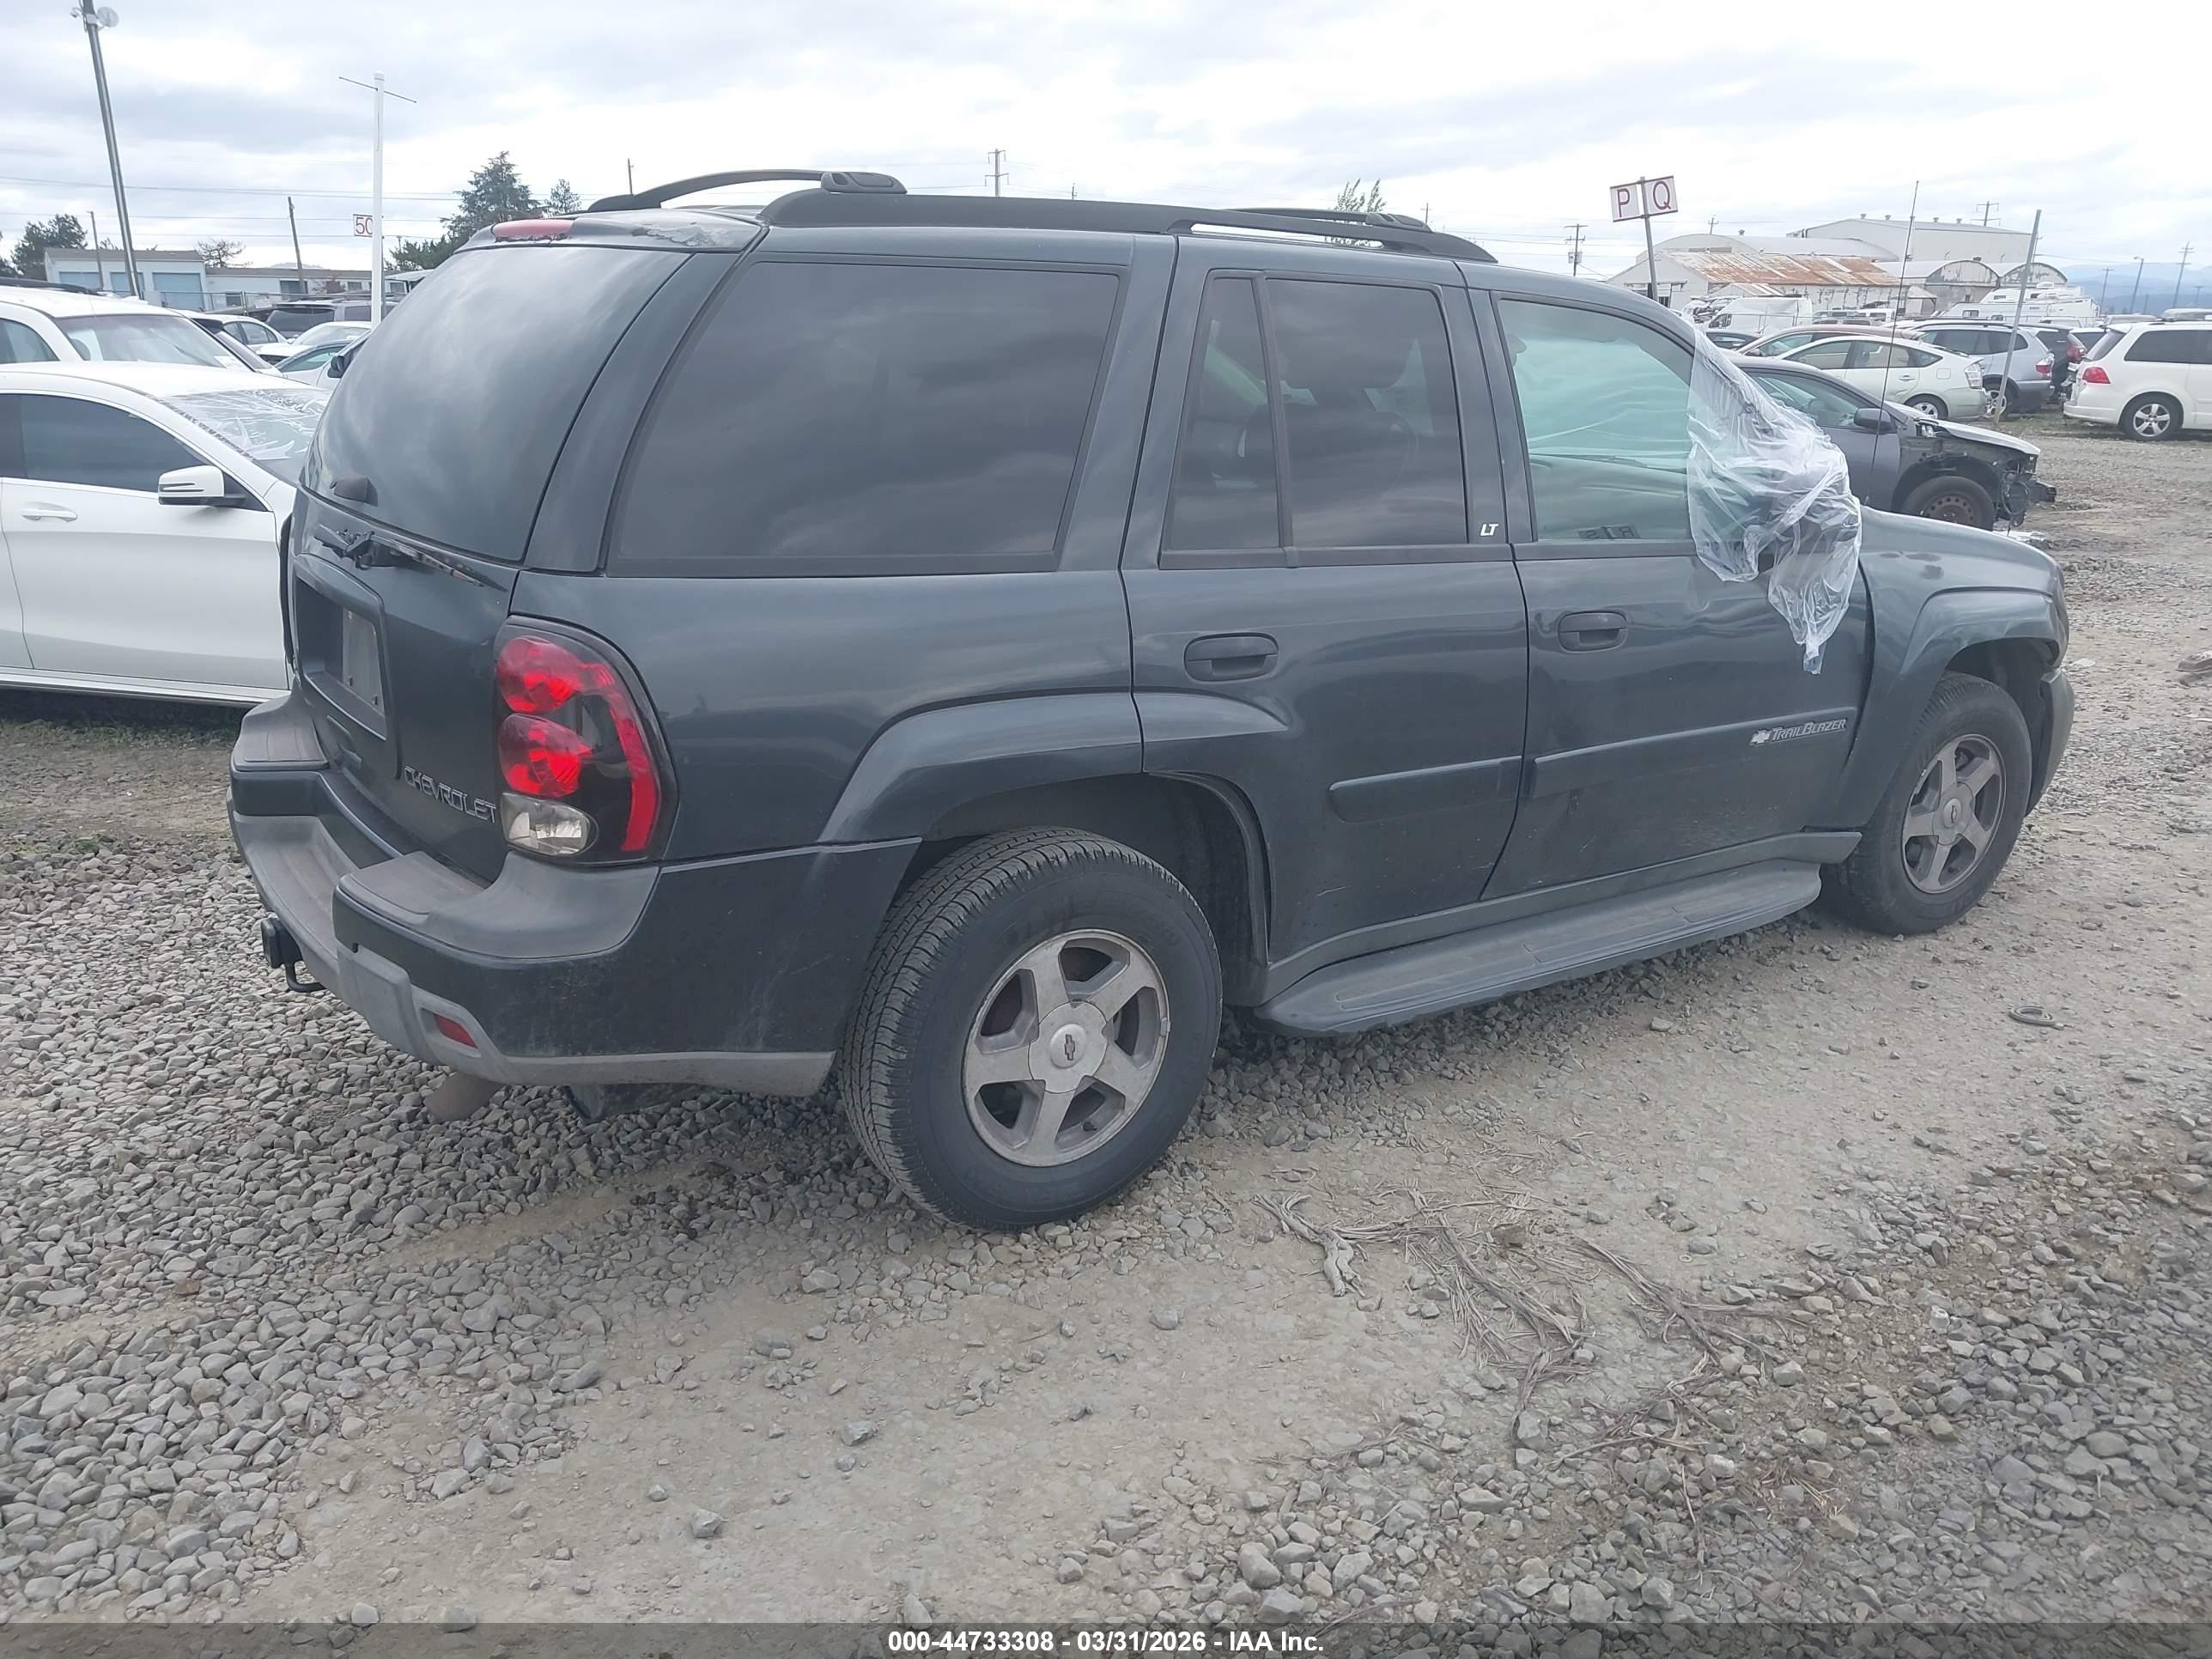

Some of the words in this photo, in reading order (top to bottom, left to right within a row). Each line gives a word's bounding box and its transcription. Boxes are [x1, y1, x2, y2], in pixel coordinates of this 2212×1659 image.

[1617, 188, 1630, 217] P
[1653, 180, 1671, 210] Q
[1480, 523, 1499, 536] LT
[404, 765, 496, 823] CHEVROLET
